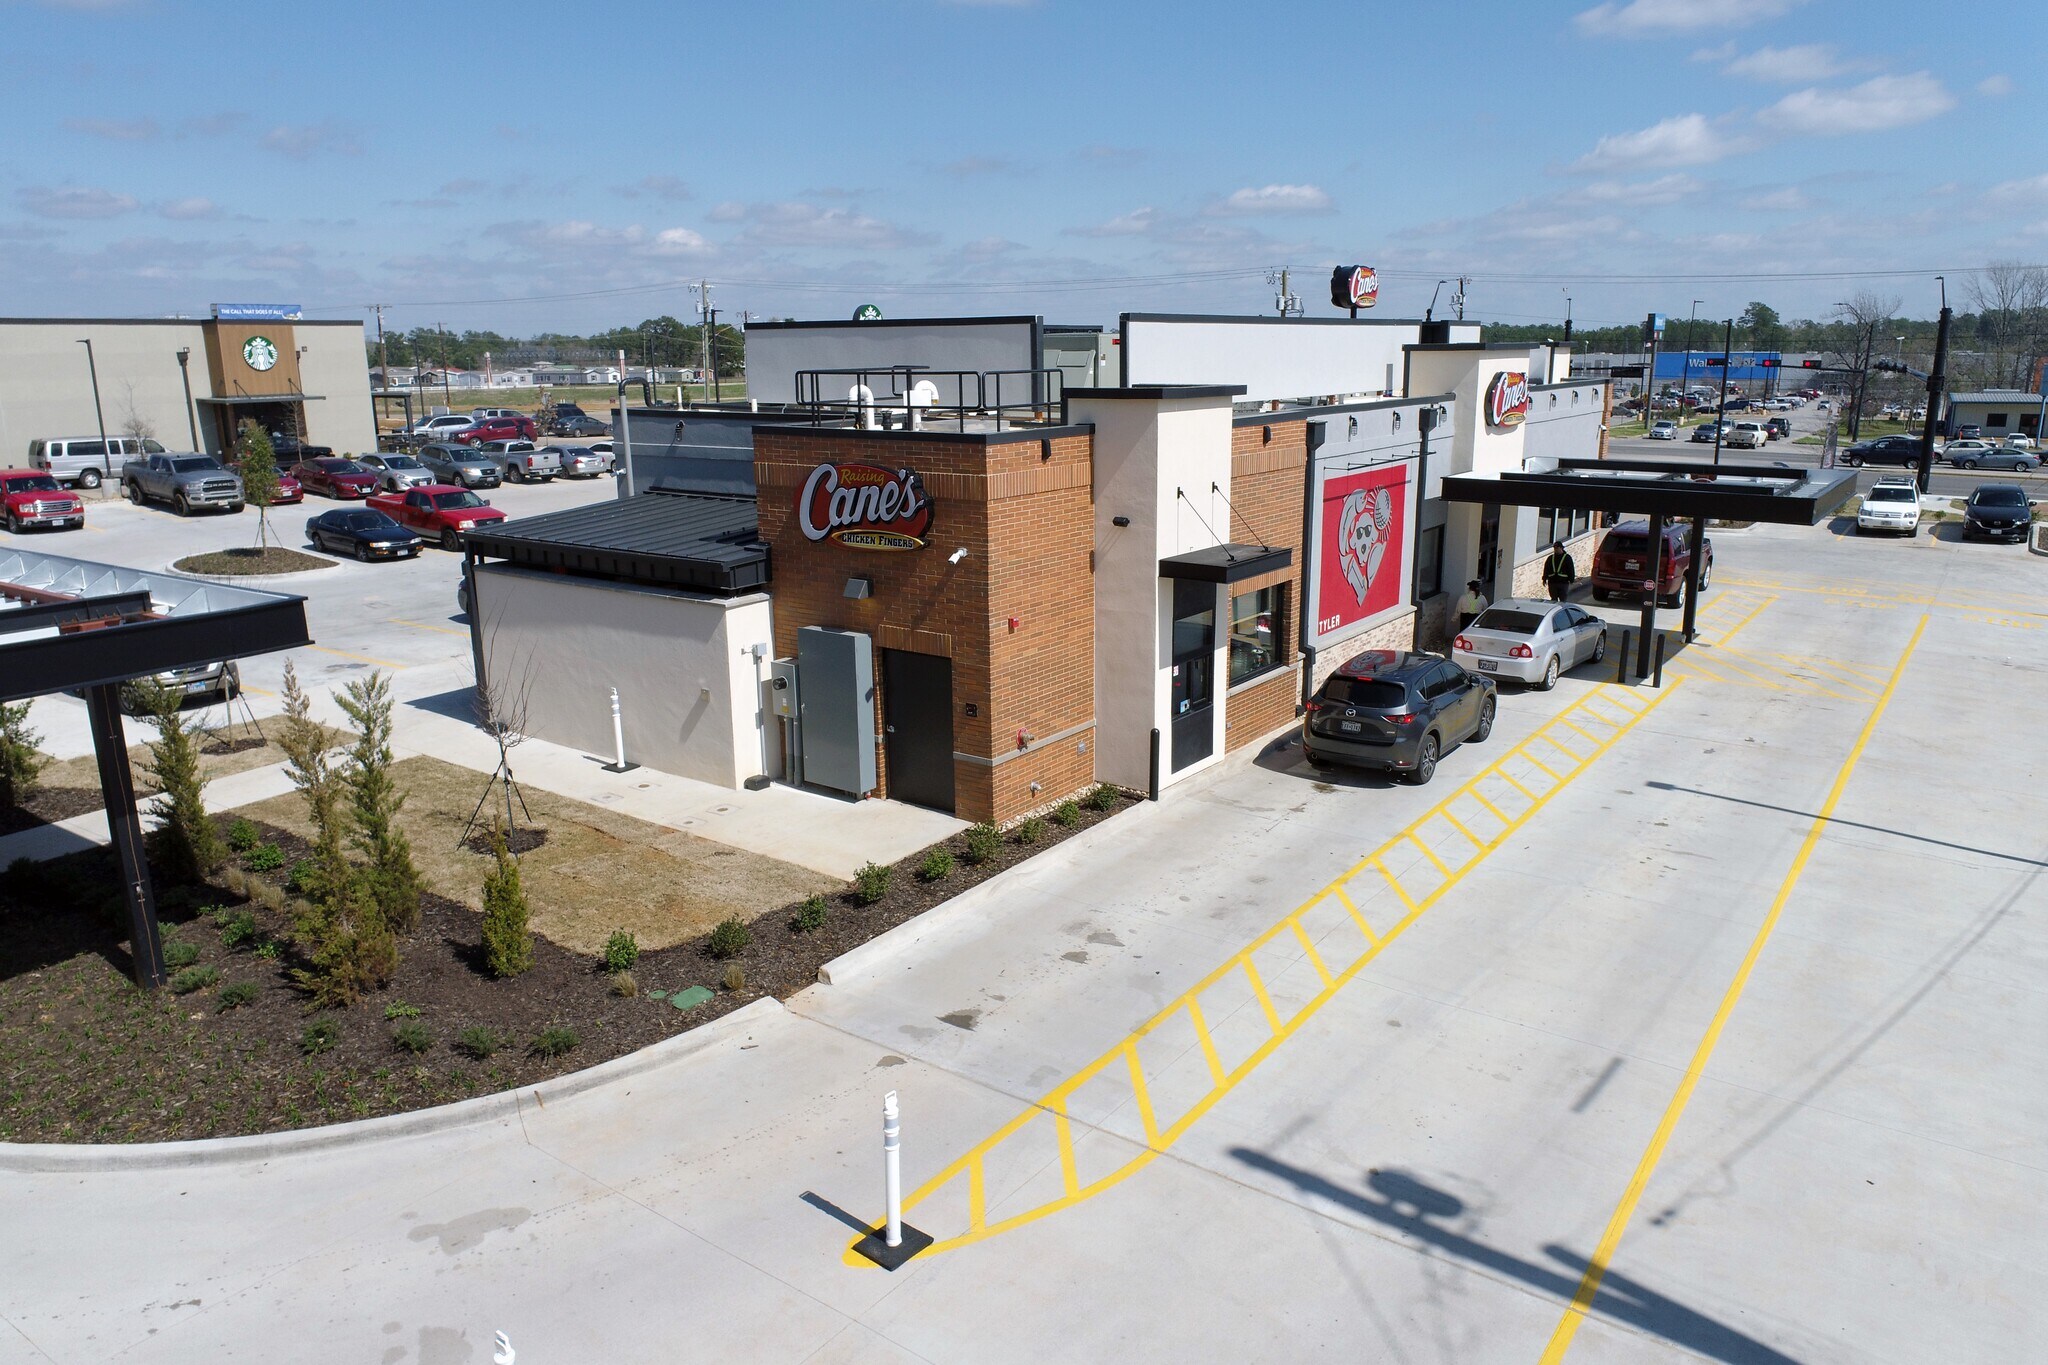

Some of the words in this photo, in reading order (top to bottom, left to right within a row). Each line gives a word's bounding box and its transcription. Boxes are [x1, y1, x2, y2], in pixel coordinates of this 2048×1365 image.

[840, 468, 886, 486] Raising
[800, 463, 924, 541] Cane's
[841, 532, 876, 545] CHICKEN
[878, 535, 914, 549] FINGERS
[1319, 614, 1340, 633] TYLER
